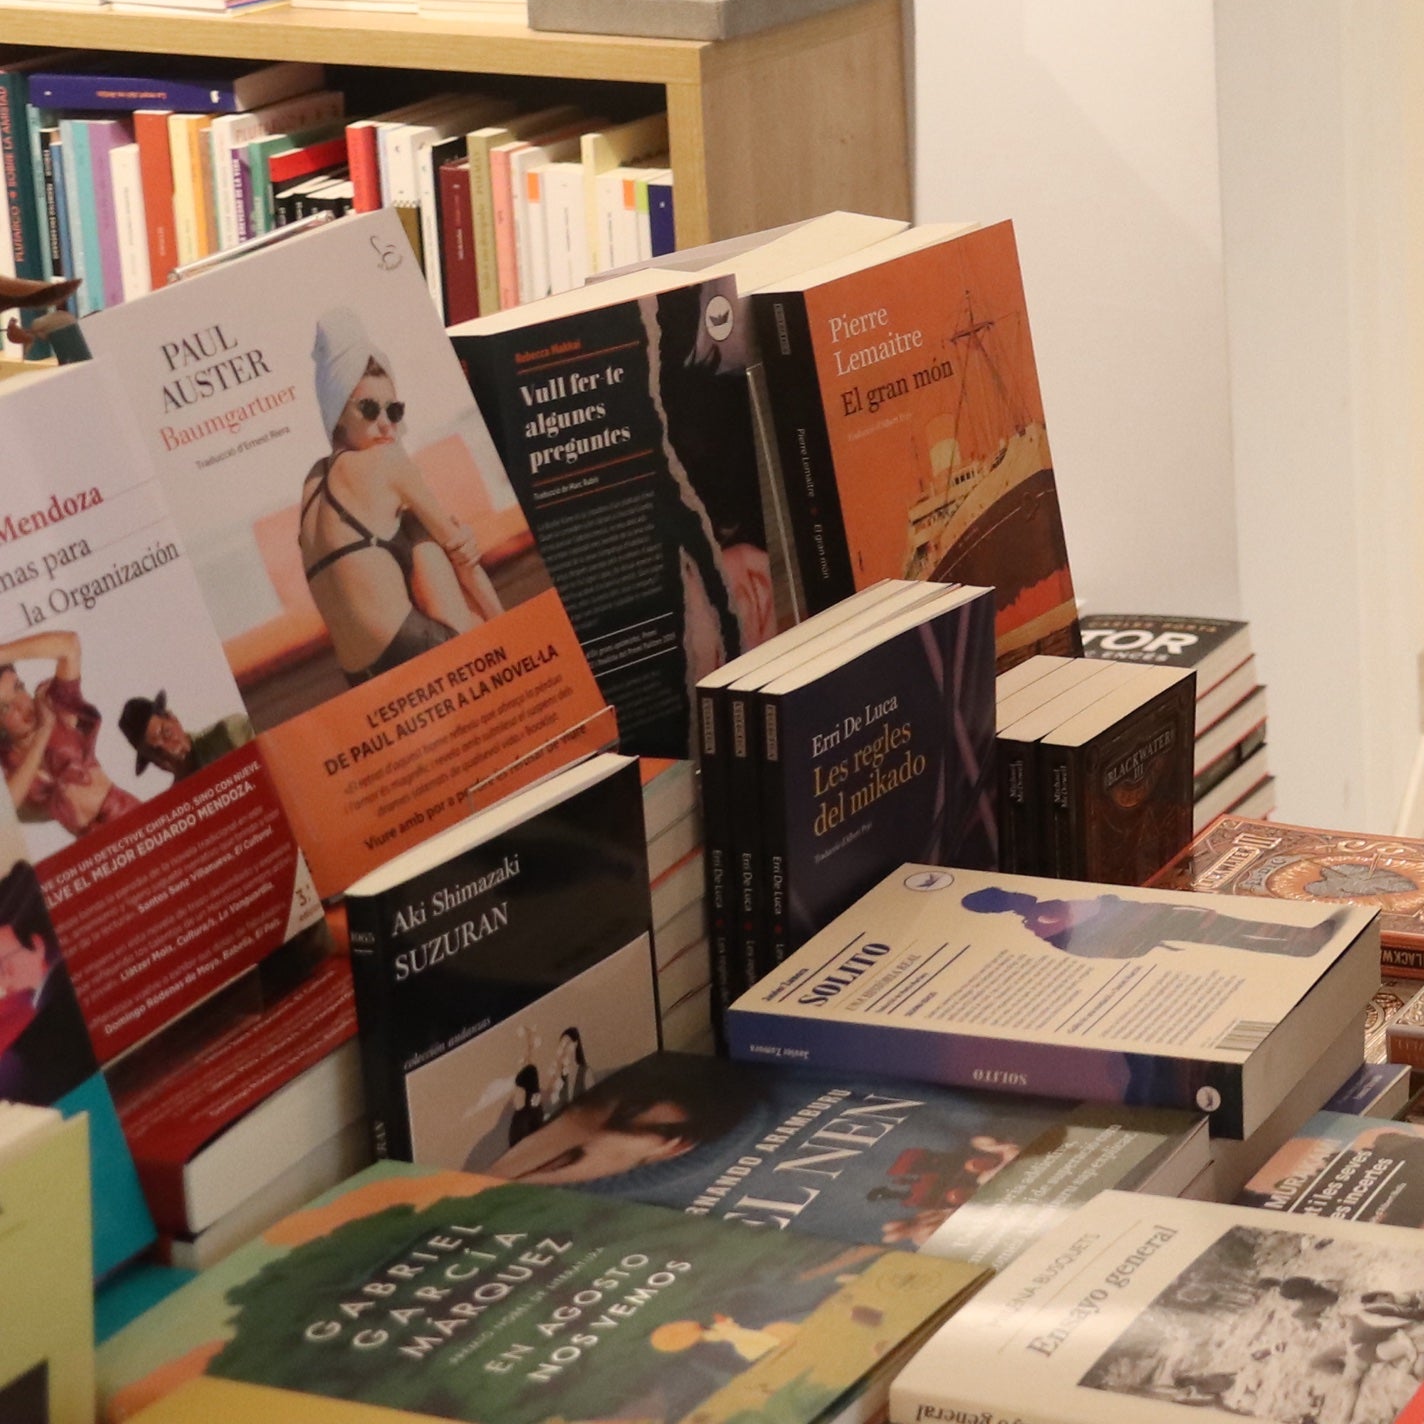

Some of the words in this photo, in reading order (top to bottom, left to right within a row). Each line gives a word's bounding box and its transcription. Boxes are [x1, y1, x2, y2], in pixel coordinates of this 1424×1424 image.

[10, 206, 26, 263] PLUTARCO
[161, 325, 239, 372] PAUL
[828, 307, 890, 344] Pierre
[834, 326, 925, 376] Lemaitre
[163, 349, 272, 414] AUSTER
[520, 374, 568, 408] Vull
[568, 364, 626, 396] fer-te
[840, 388, 864, 417] El
[866, 377, 910, 414] gran
[912, 359, 955, 387] món
[160, 385, 297, 453] Baumgartner
[525, 403, 608, 439] algunes
[529, 426, 632, 475] preguntes
[0, 485, 105, 545] Mendoza
[21, 601, 48, 627] la
[49, 542, 181, 610] Organización
[42, 538, 93, 581] para
[1081, 628, 1199, 655] TOR
[367, 677, 449, 729] L'ESPERAT
[449, 646, 509, 688] RETORN
[324, 752, 351, 777] DE
[351, 733, 395, 763] PAUL
[396, 699, 456, 741] AUSTER
[457, 693, 470, 708] A
[472, 680, 490, 702] LA
[812, 723, 841, 759] Erri
[844, 715, 863, 740] De
[864, 694, 898, 728] Luca
[814, 760, 849, 799] Les
[854, 721, 912, 773] regles
[814, 792, 845, 838] del
[850, 750, 926, 816] mikado
[56, 866, 78, 884] CON
[78, 857, 94, 875] UN
[94, 827, 144, 864] DETECTIVE
[215, 775, 234, 795] CON
[74, 874, 92, 893] EL
[92, 851, 136, 883] MEJOR
[137, 815, 198, 858] EDUARDO
[198, 782, 257, 821] MENDOZA.
[365, 828, 398, 852] Viure
[398, 813, 425, 834] amb
[427, 803, 447, 822] por
[391, 902, 427, 938] Aki
[431, 853, 521, 919] Shimazaki
[395, 902, 510, 981] SUZURAN
[797, 942, 891, 1008] SOLITO
[972, 1067, 1027, 1086] SOLITO
[755, 1088, 853, 1153] ARAMBURU
[772, 1092, 928, 1181] NEN
[1313, 1180, 1344, 1201] les
[1335, 1150, 1373, 1182] seves
[1336, 1158, 1394, 1205] incertes
[305, 1223, 483, 1342] GABRIEL
[352, 1230, 528, 1350] GARCÍA
[399, 1236, 573, 1359] MÁRQUEZ
[485, 1342, 535, 1375] EN
[536, 1252, 649, 1338] AGOSTO
[1026, 1288, 1109, 1358] Ensayo
[1105, 1224, 1180, 1289] general
[527, 1331, 599, 1383] NOS
[590, 1259, 693, 1332] VEMOS
